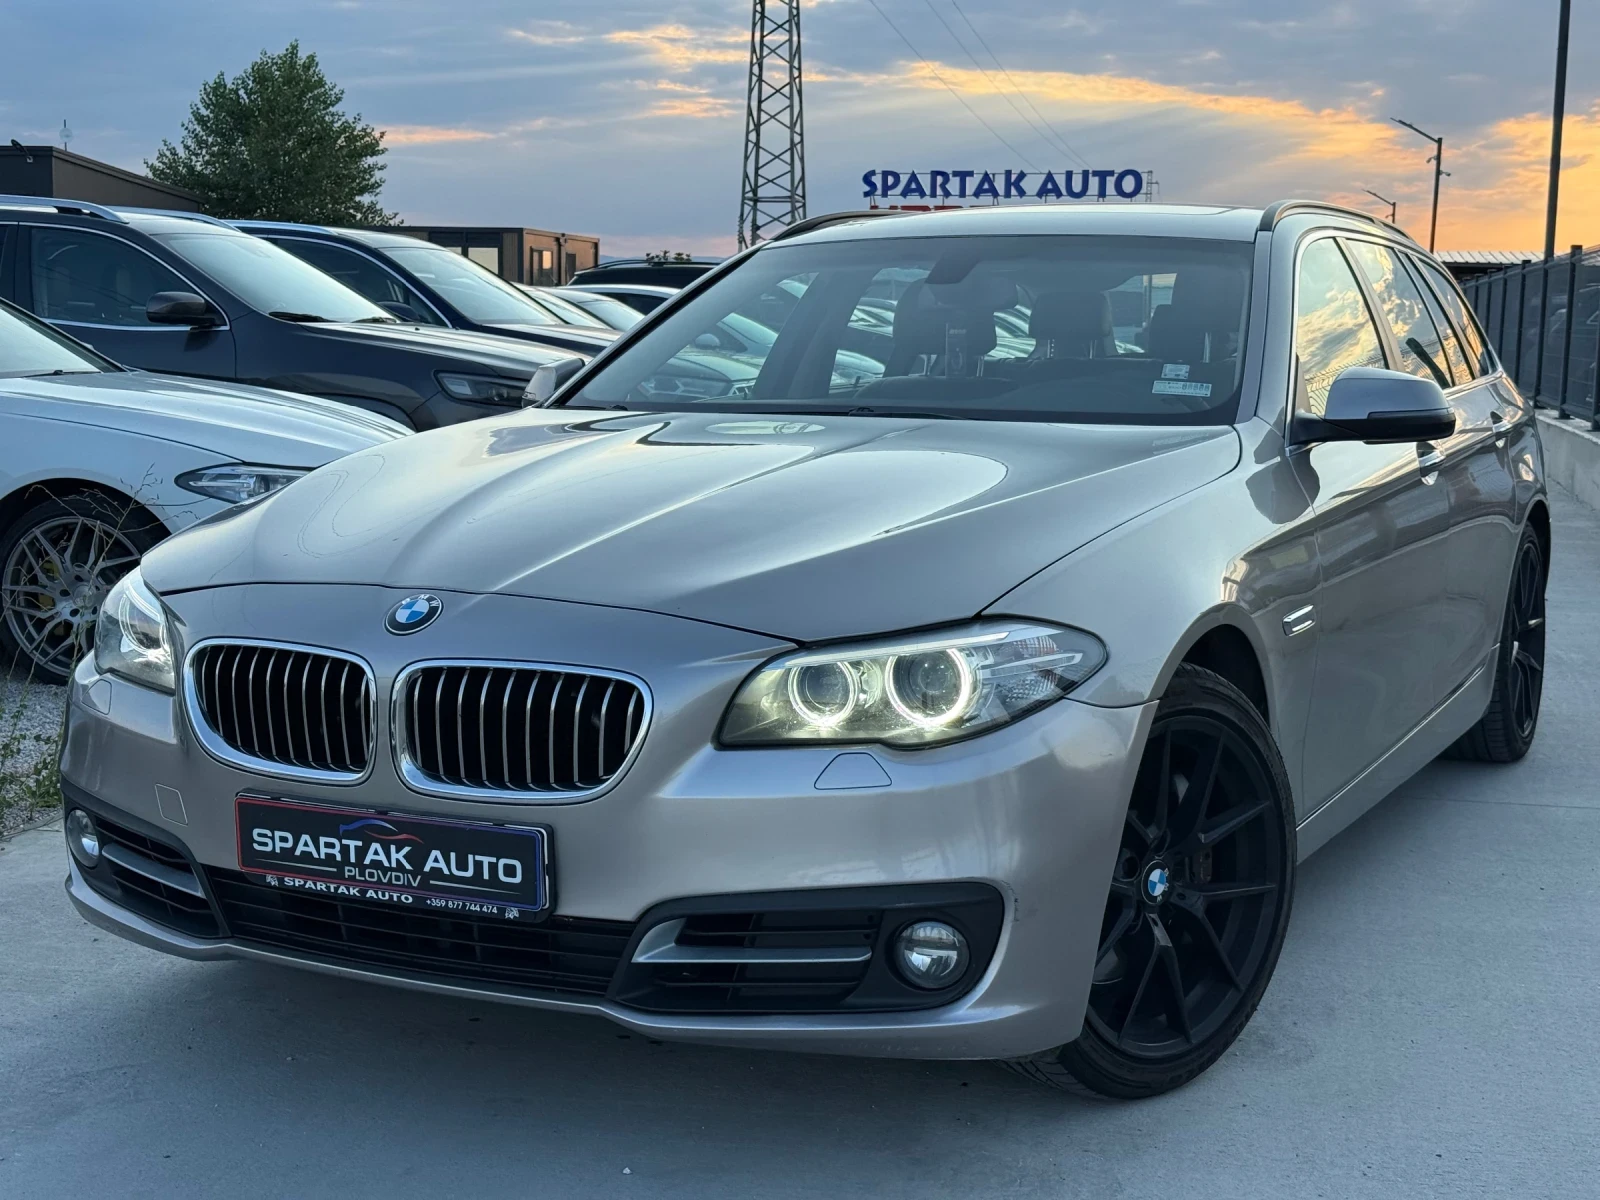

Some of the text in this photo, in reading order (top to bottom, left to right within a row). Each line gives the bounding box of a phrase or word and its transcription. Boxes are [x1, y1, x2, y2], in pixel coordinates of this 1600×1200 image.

[862, 169, 1143, 199] SPARTAK AUTO
[252, 828, 522, 884] SPARTAK AUTO
[344, 866, 421, 887] PLOVDIV
[284, 877, 498, 914] SPARTAK AUTO +359 877 744 474
